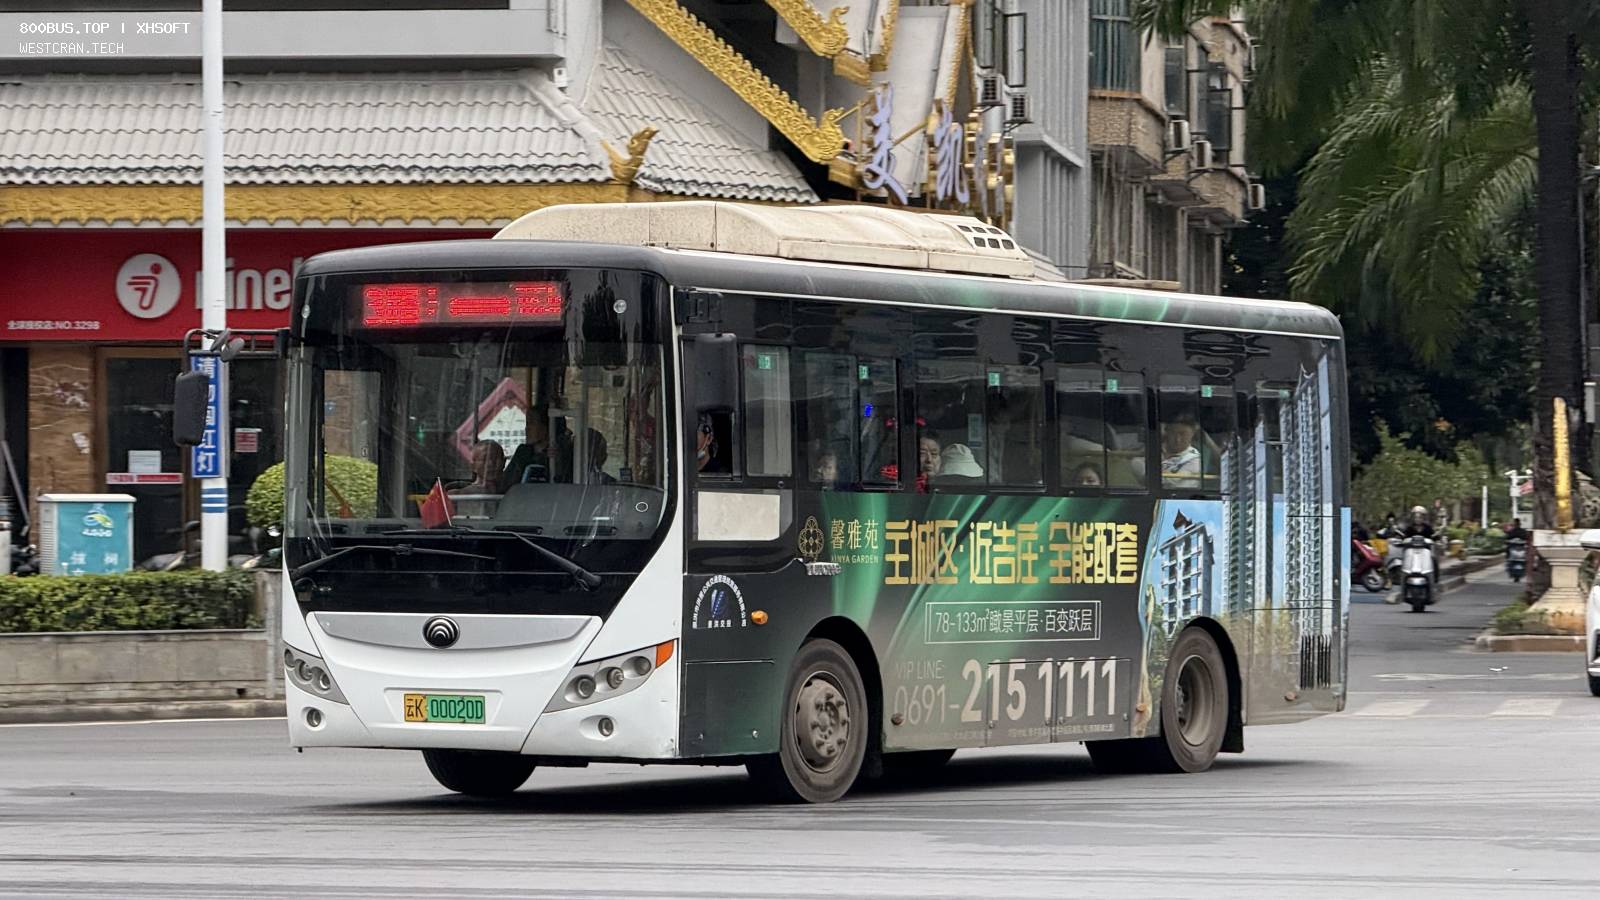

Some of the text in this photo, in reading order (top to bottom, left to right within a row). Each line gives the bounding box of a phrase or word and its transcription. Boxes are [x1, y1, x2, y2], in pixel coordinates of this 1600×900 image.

[195, 257, 304, 310] ine
[831, 518, 879, 550] 馨雅苑
[851, 554, 879, 564] GARDEN
[897, 661, 913, 681] VIP
[1037, 655, 1117, 725] 1111
